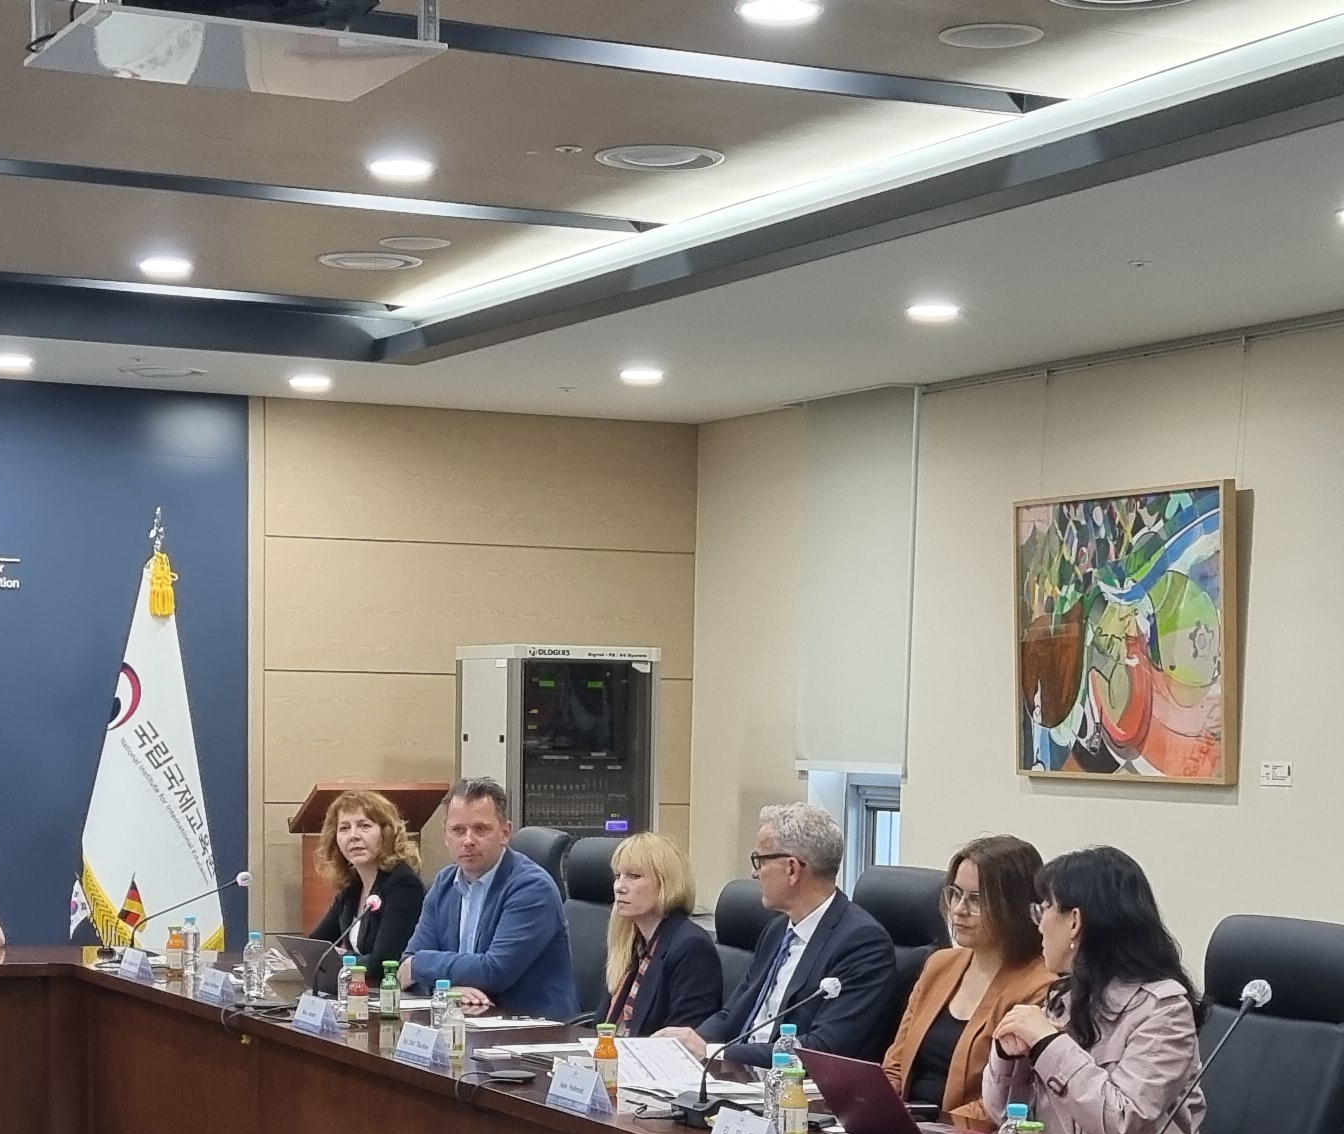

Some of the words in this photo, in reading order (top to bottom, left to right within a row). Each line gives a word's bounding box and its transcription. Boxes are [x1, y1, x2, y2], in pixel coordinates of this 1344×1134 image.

[120, 736, 140, 766] National
[138, 764, 161, 794] Institute
[165, 803, 194, 850] International
